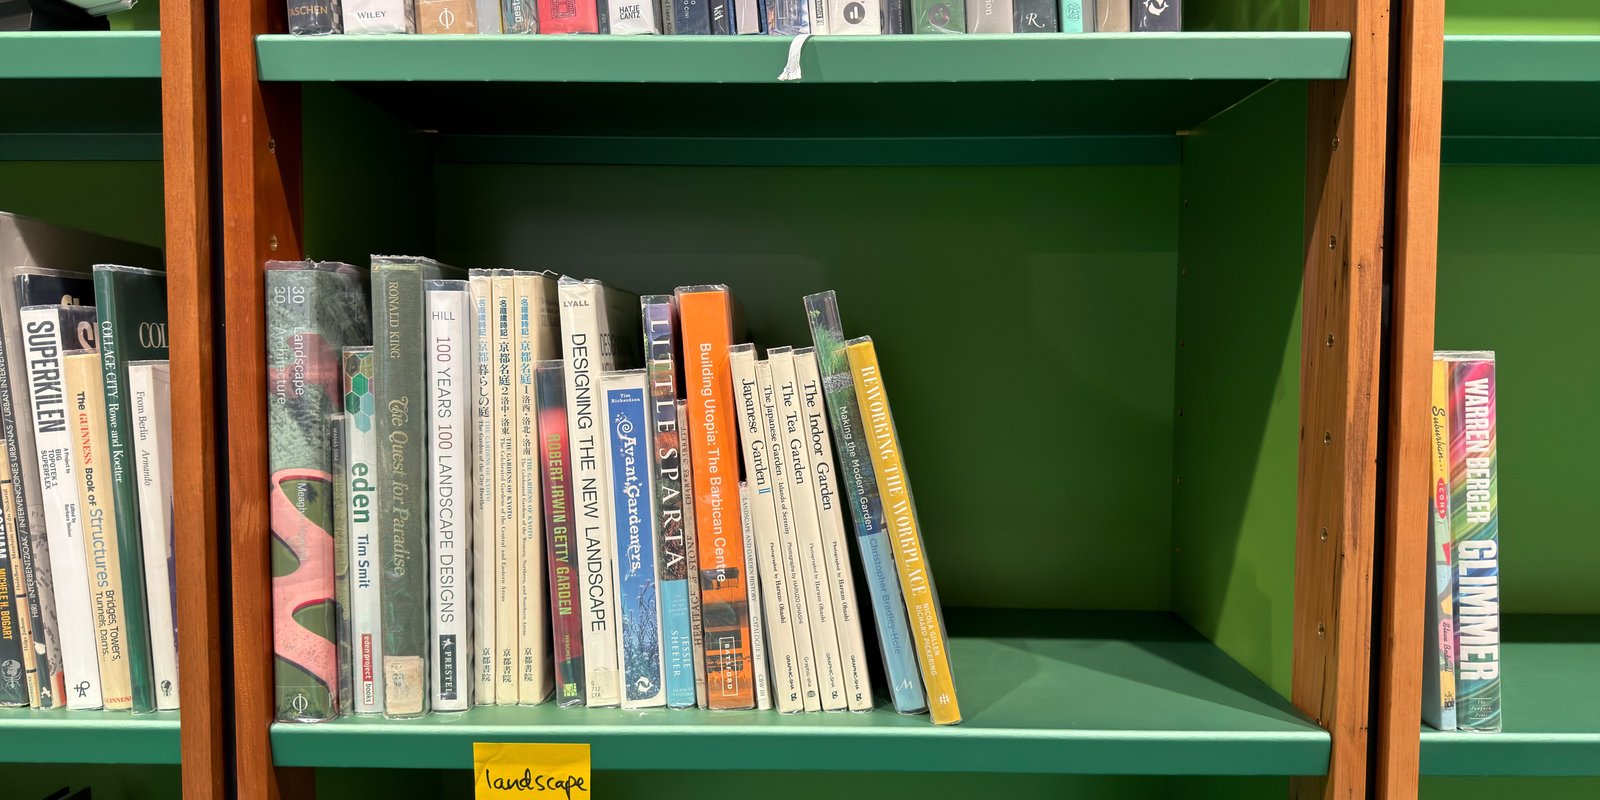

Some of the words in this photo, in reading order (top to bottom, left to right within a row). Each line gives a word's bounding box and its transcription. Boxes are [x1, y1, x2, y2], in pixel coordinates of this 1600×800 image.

[357, 11, 387, 19] WILEY
[619, 4, 640, 13] HATJE
[619, 12, 641, 20] CANTZ
[273, 286, 286, 304] 30
[292, 286, 305, 304] 30
[388, 281, 400, 328] RONALD
[563, 299, 590, 308] LYALL
[432, 311, 456, 321] HILL
[101, 320, 115, 371] COLLAGE
[293, 326, 308, 396] Landscape
[390, 331, 400, 359] KING
[436, 337, 452, 363] 100
[26, 320, 66, 433] SUPERKILEN
[273, 327, 287, 405] Architecture
[571, 333, 593, 430] DESIGNING
[650, 319, 676, 433] LITTLE
[699, 343, 713, 397] Building
[77, 391, 86, 411] The
[106, 374, 119, 403] CITY
[136, 391, 145, 417] From
[437, 367, 452, 419] YEARS
[763, 384, 772, 404] The
[781, 381, 794, 407] The
[804, 379, 816, 408] The
[108, 403, 120, 429] Rowe
[138, 417, 149, 441] Berlin
[388, 395, 409, 427] The
[704, 398, 719, 447] Utopia:
[764, 404, 777, 442] Japanese
[786, 410, 798, 434] Tea
[839, 406, 852, 441] Making
[861, 365, 895, 460] REWORKING
[1464, 377, 1490, 453] WARREN
[6, 424, 18, 461] URBANAS
[79, 412, 93, 465] GUINNESS
[111, 431, 123, 447] and
[438, 424, 453, 450] 100
[742, 378, 758, 434] Japanese
[751, 439, 768, 486] Garden
[808, 412, 824, 456] Indoor
[845, 441, 856, 459] the
[41, 450, 52, 490] SUPERFLEX
[48, 449, 58, 481] TOPOTEK
[113, 448, 124, 483] Koetter
[389, 430, 408, 477] Quest
[548, 434, 564, 485] ROBERT
[579, 436, 596, 471] THE
[708, 447, 720, 474] The
[772, 444, 782, 476] Garden
[790, 438, 806, 485] Garden
[10, 463, 27, 527] INTERVENCIONES
[85, 467, 95, 493] Book
[351, 462, 375, 523] eden
[816, 461, 834, 511] Garden
[850, 458, 865, 495] Modern
[884, 463, 904, 497] THE
[1465, 457, 1491, 524] BERGER
[88, 494, 97, 506] of
[438, 455, 454, 549] LANDSCAPE
[551, 485, 565, 523] IRWIN
[582, 478, 599, 519] NEW
[659, 447, 685, 568] SPARTA
[709, 476, 723, 536] Barbican
[859, 496, 873, 531] Garden
[782, 506, 790, 535] Serenity
[89, 508, 109, 588] Structures
[357, 533, 369, 558] Tim
[392, 506, 411, 576] Paradise
[554, 526, 569, 563] GETTY
[769, 542, 778, 572] Photographed
[892, 501, 927, 597] WORKPLACE
[358, 558, 370, 589] Smit
[585, 526, 606, 632] LANDSCAPE
[714, 539, 727, 582] Centre
[440, 554, 454, 624] DESIGNS
[556, 566, 572, 616] GARDEN
[775, 580, 783, 602] Haruzo
[869, 538, 887, 593] Christopher
[881, 594, 901, 655] Bradley-Hole
[2, 611, 13, 640] BOGART
[31, 604, 39, 618] HIRI
[95, 592, 106, 628] Tunnels,
[105, 590, 117, 627] Bridges,
[778, 603, 787, 624] Ohashi
[787, 542, 796, 573] Photographs
[793, 580, 801, 603] HARUZO
[804, 656, 812, 688] Graphic-sha
[809, 543, 818, 574] Photographed
[818, 603, 827, 623] Ohashi
[826, 652, 836, 688] GRAPHIC-SHA
[832, 540, 841, 571] Photographed
[838, 579, 846, 601] Haruzo
[842, 601, 850, 622] Ohashi
[850, 654, 860, 691] GRAPHIC-SHA
[1458, 540, 1499, 681] GLIMMER
[110, 627, 121, 662] Towers,
[915, 605, 928, 636] RICHARD
[924, 637, 938, 676] PICKERING
[923, 602, 935, 630] NICOLA
[929, 631, 940, 657] GILLEN
[670, 630, 681, 677] SHEELER
[681, 636, 691, 669] JESSIE
[724, 643, 733, 690] BATSFORD
[443, 651, 453, 694] PRESTEL
[785, 654, 795, 690] GRAPHIC-SHA
[365, 683, 373, 703] books
[486, 768, 588, 800] landscape
